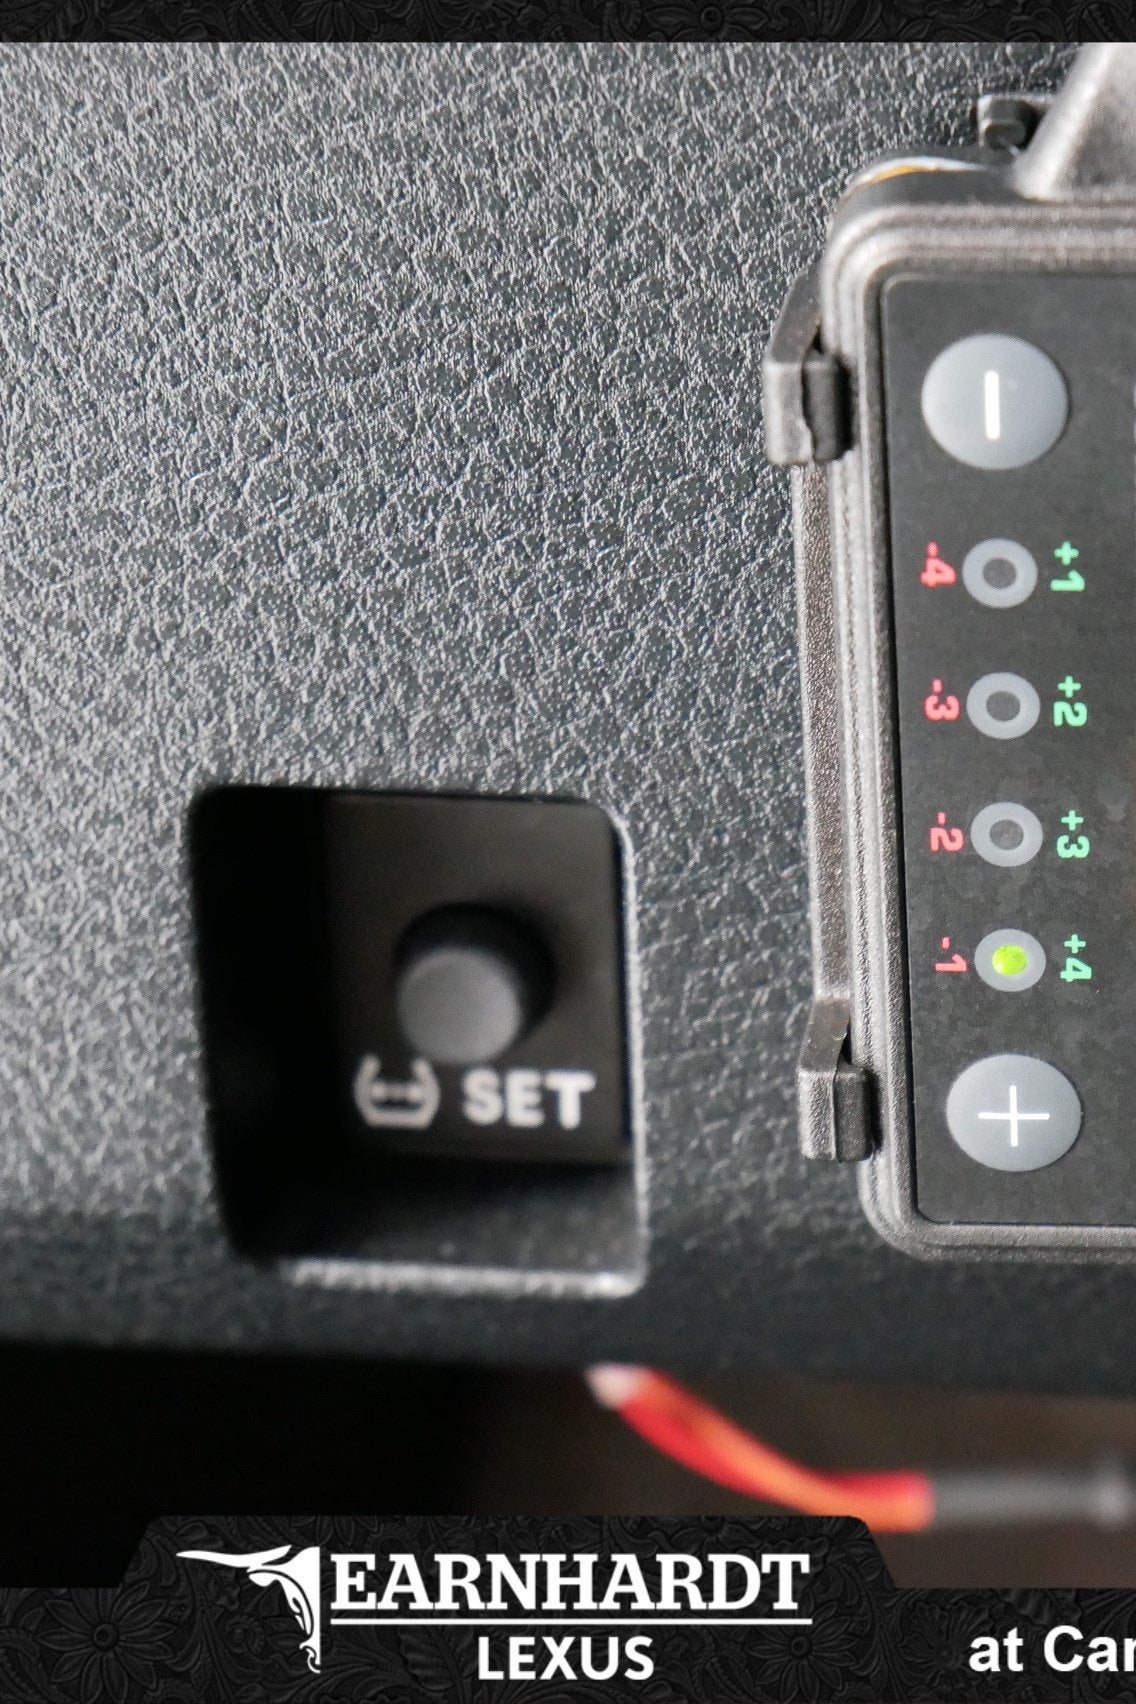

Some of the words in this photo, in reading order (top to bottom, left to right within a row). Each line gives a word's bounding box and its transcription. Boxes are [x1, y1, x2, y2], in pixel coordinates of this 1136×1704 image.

[918, 541, 957, 588] -4
[1049, 541, 1086, 592] +1
[923, 679, 961, 722] -3
[1052, 674, 1088, 727] +2
[928, 812, 964, 853] -2
[1055, 809, 1091, 859] +3
[934, 936, 968, 974] -1
[1059, 934, 1093, 983] +4
[462, 1067, 597, 1129] SET
